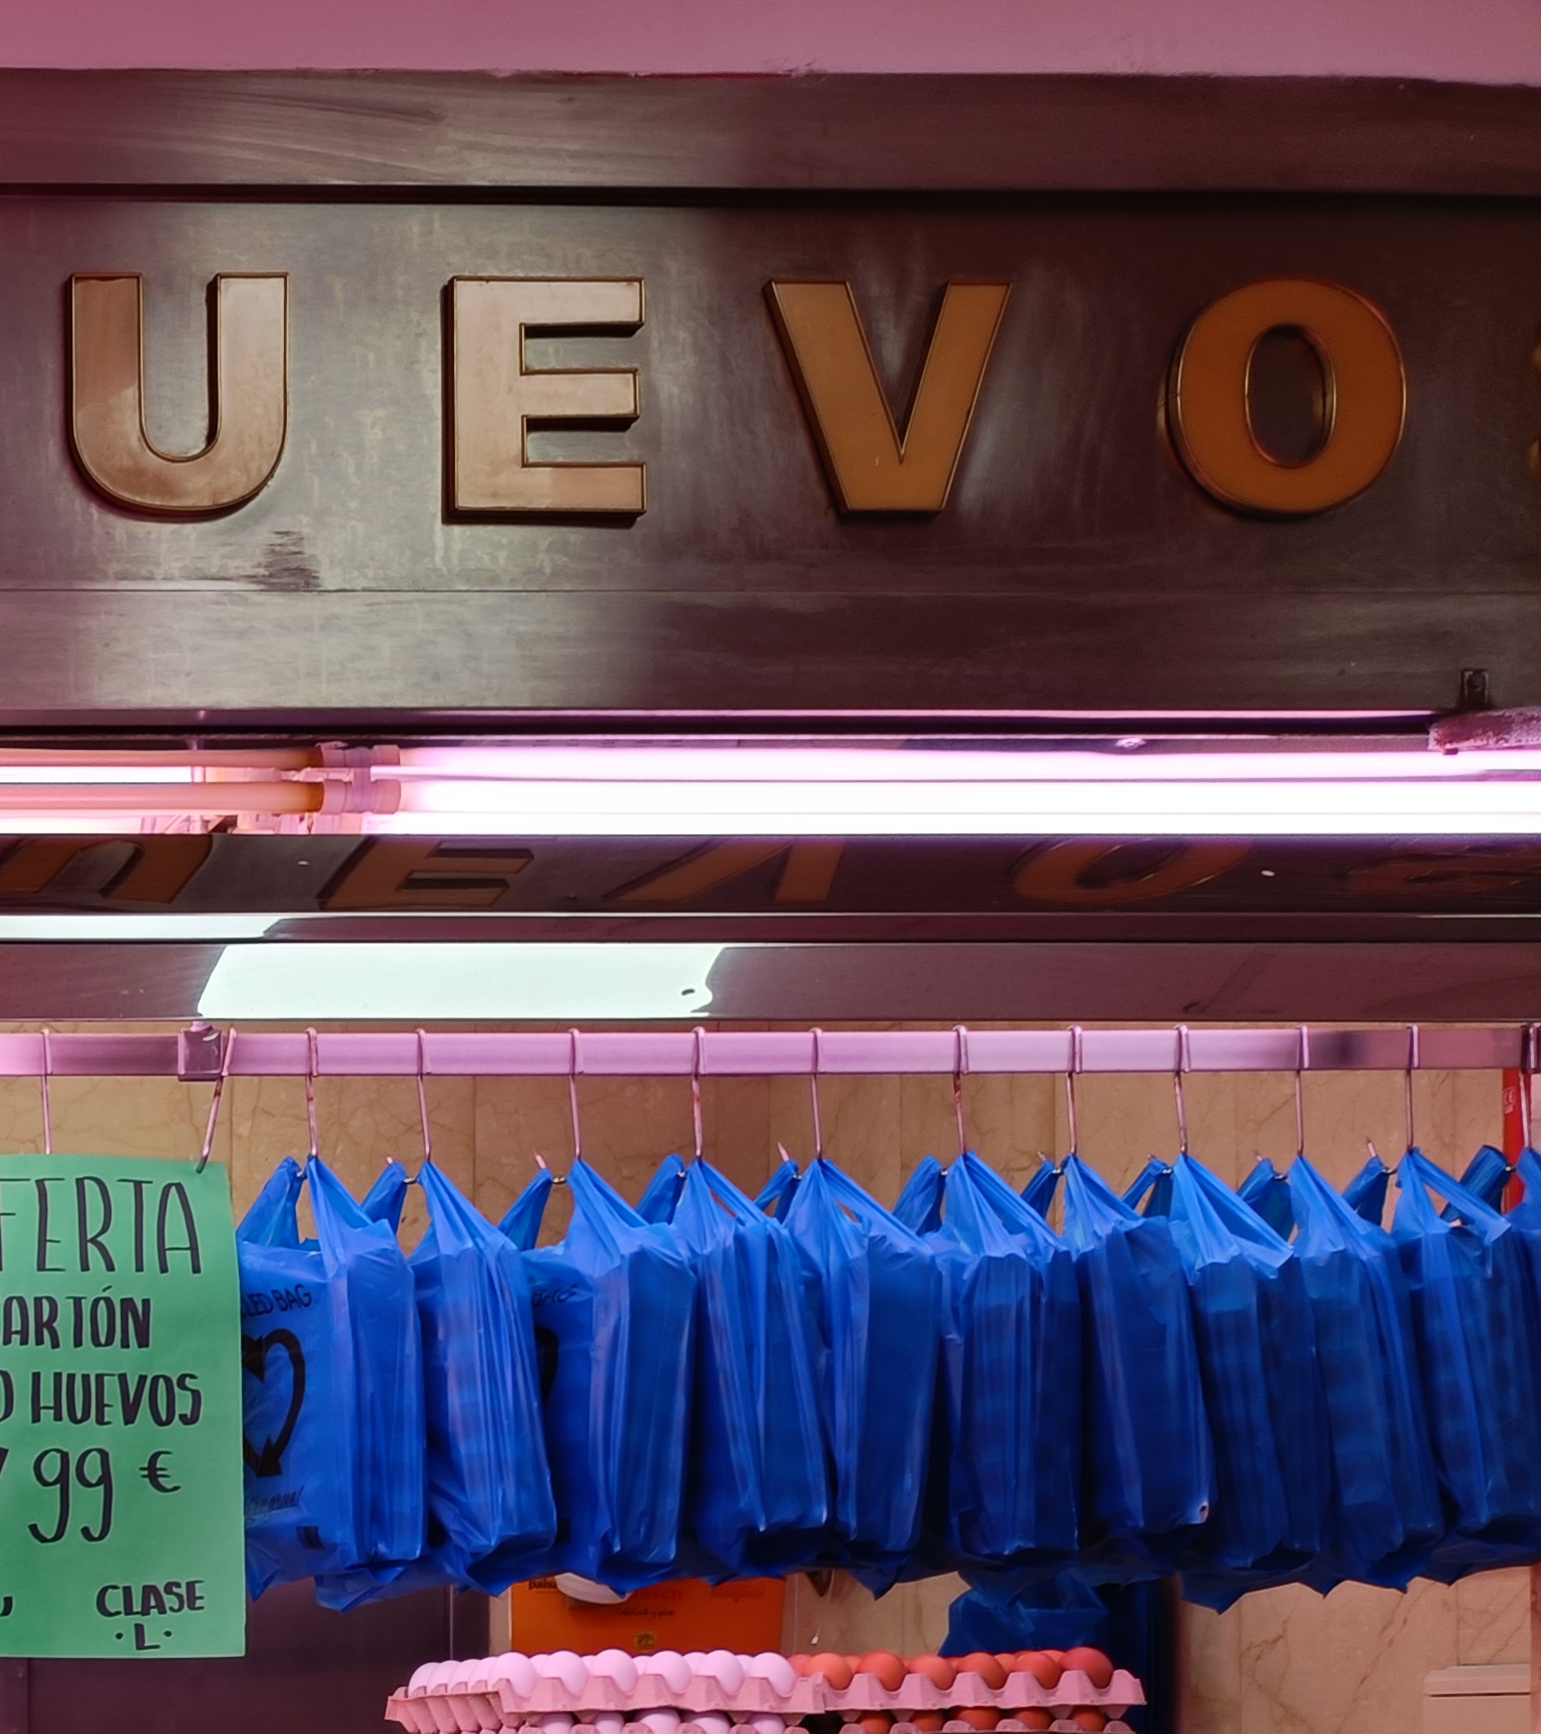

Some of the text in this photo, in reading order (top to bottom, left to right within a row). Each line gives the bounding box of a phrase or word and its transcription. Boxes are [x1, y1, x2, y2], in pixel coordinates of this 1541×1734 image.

[271, 1283, 313, 1313] BAG
[30, 1371, 203, 1427] HUEVOS
[139, 1450, 182, 1494] €
[96, 1580, 205, 1618] CLASE
